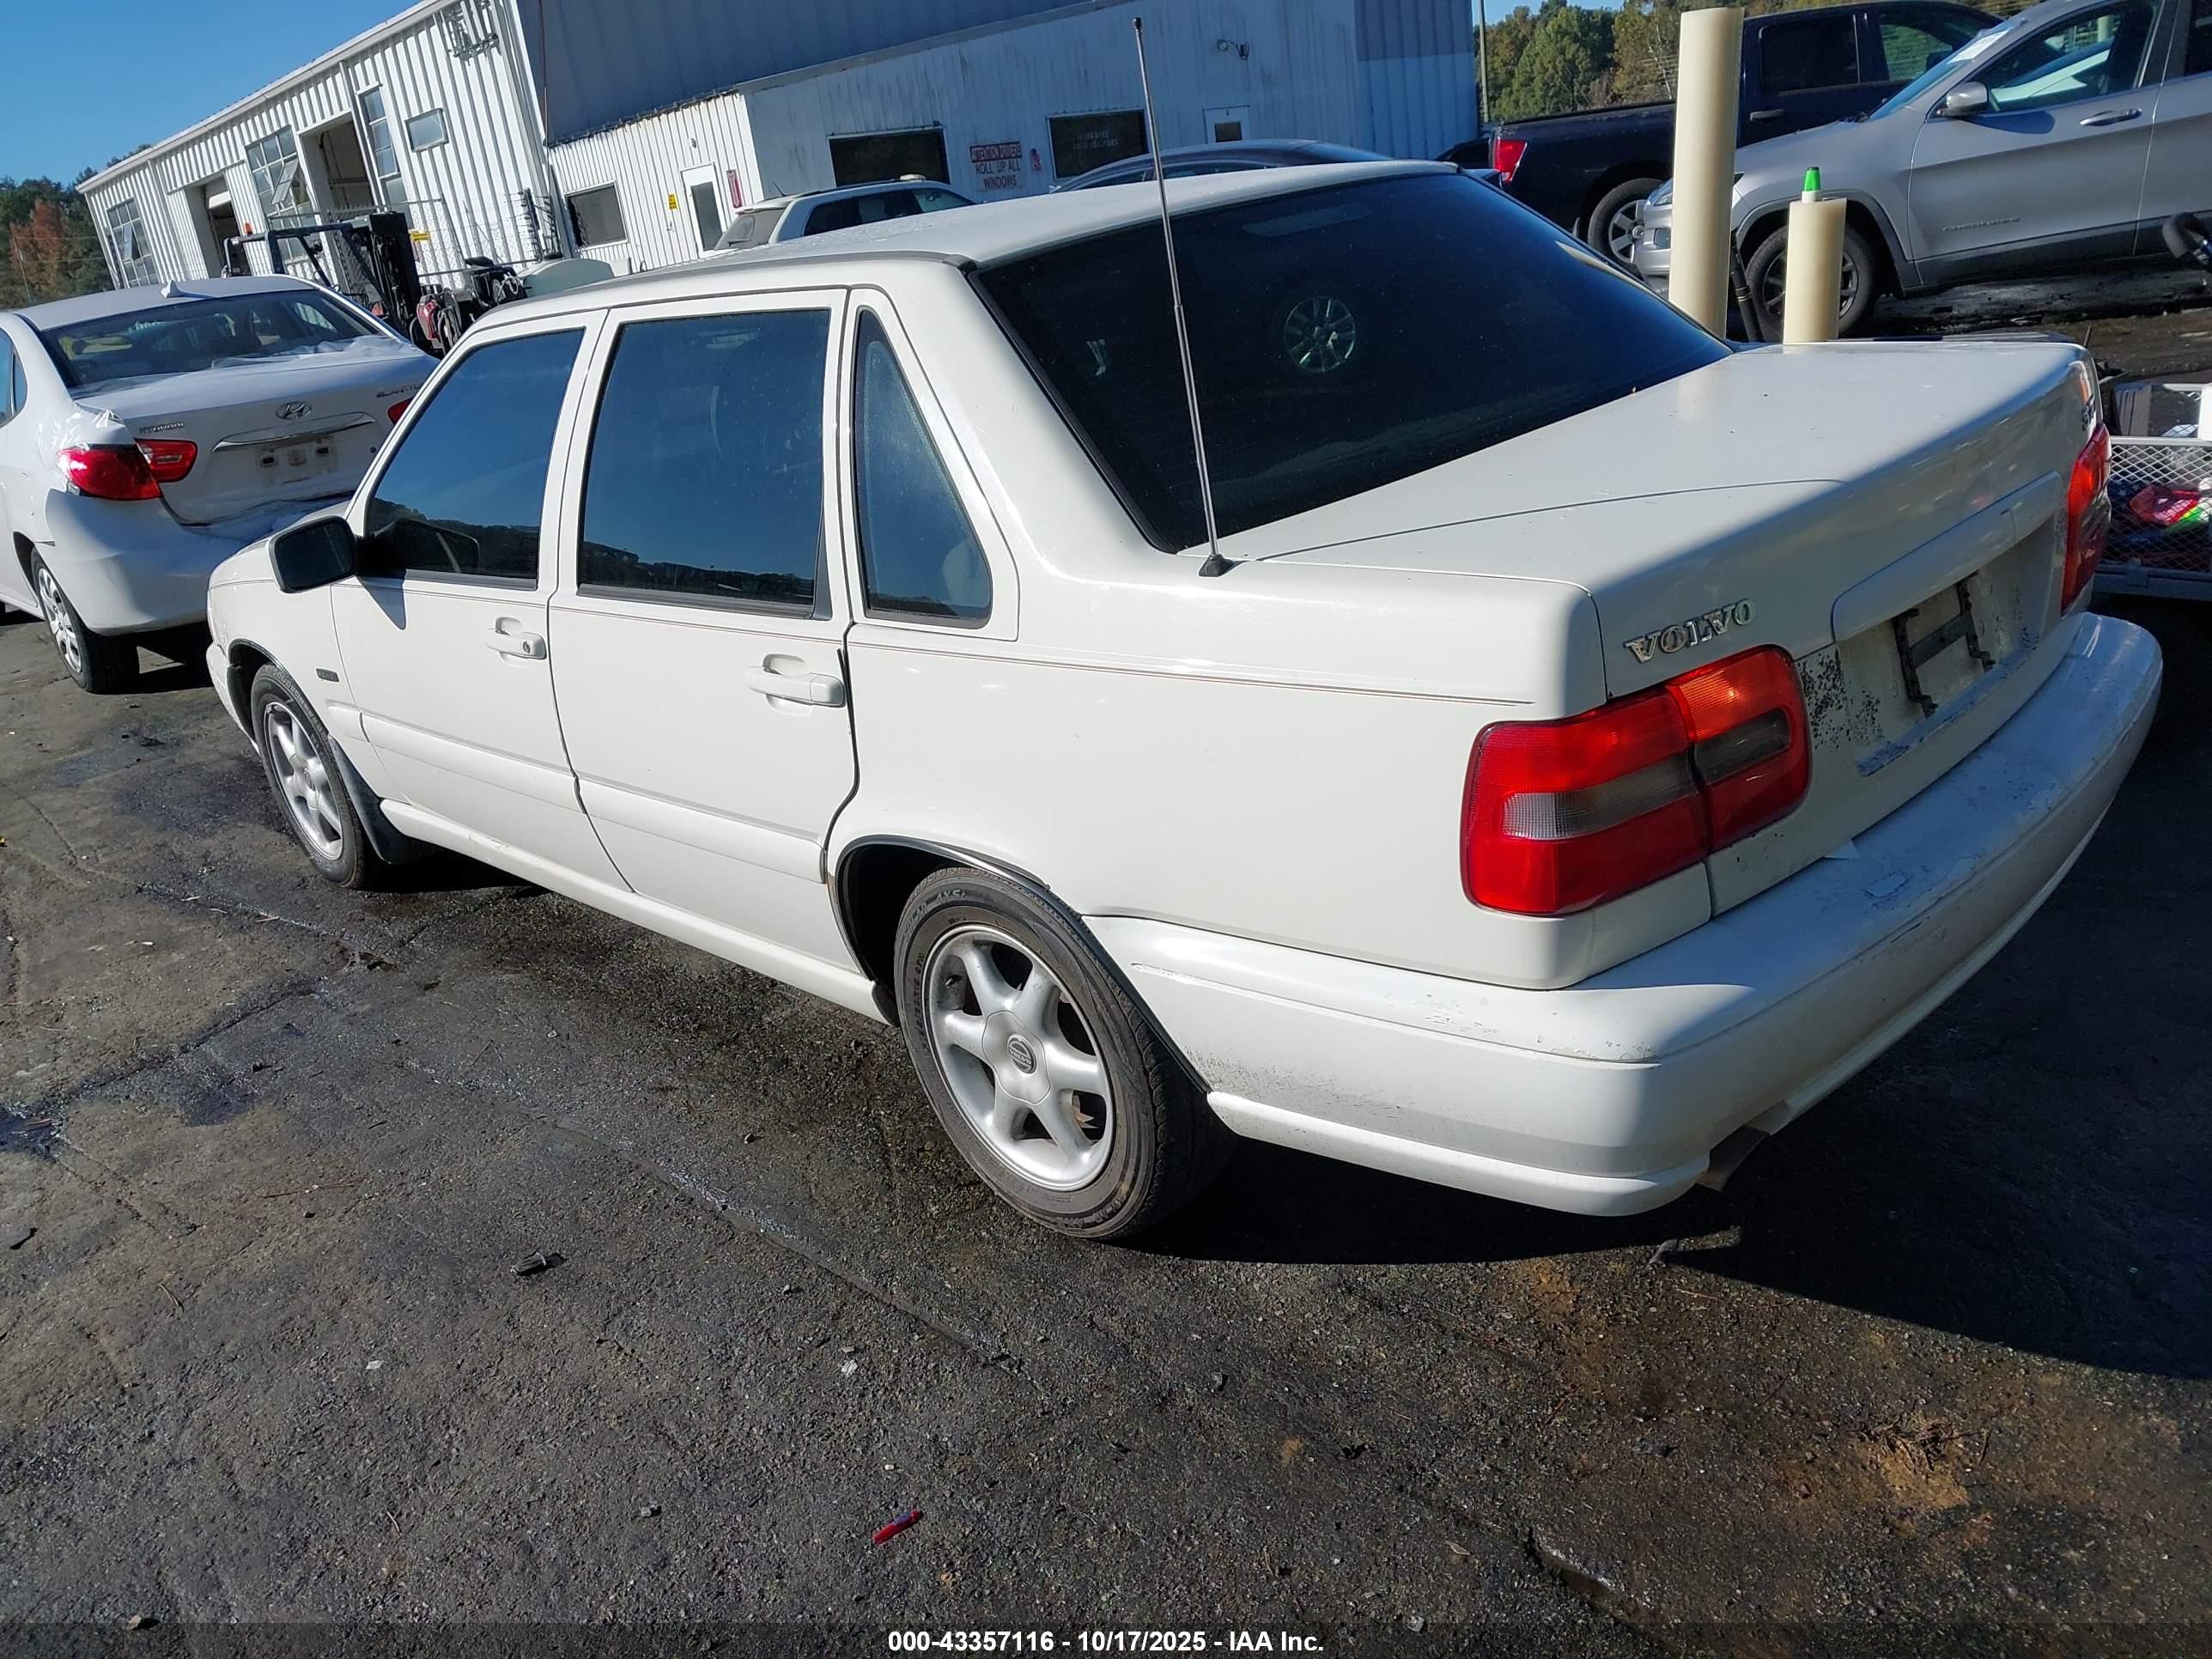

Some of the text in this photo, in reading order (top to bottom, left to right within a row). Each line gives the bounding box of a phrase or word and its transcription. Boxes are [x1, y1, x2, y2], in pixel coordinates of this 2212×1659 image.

[975, 158, 1021, 175] ROLL UP ALL
[983, 174, 1018, 189] WINDOWS
[1623, 599, 1754, 663] VOLVO
[1008, 1047, 1032, 1066] VOLVO
